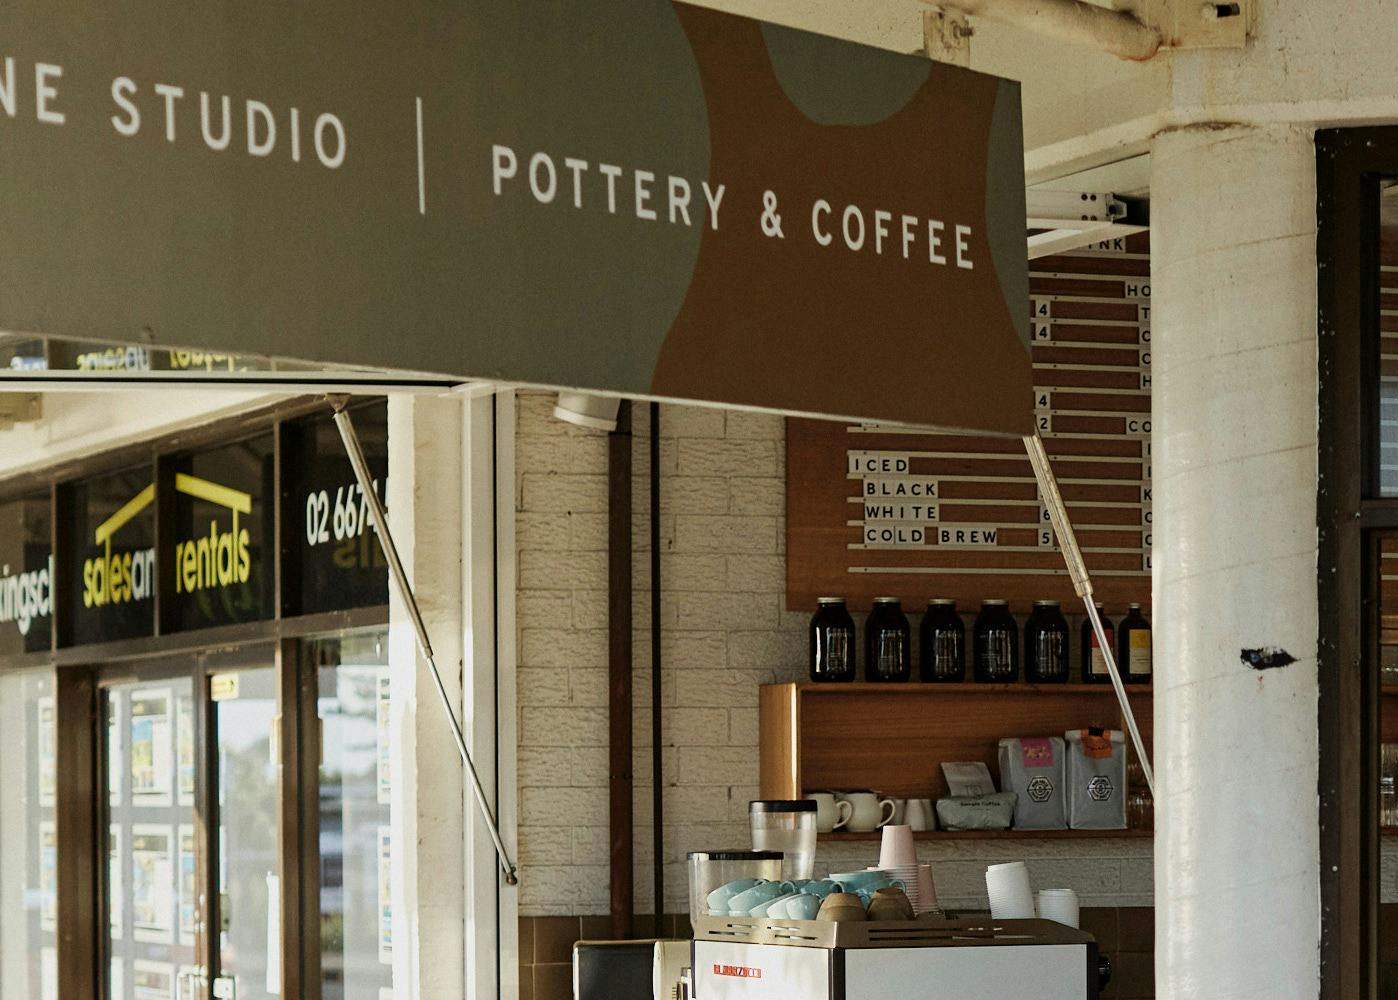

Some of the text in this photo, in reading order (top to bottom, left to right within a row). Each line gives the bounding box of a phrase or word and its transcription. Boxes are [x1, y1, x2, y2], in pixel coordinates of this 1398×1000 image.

[111, 76, 348, 169] STUDIO
[492, 144, 975, 269] POTTERY & COFFEE
[1038, 304, 1048, 316] 4
[1038, 326, 1048, 338] 4
[1038, 394, 1048, 407] 4
[1040, 417, 1048, 430] 2
[855, 458, 907, 472] ICED
[866, 482, 936, 496] BLACK
[306, 490, 330, 546] 02
[866, 506, 1051, 520] WHITE 6
[866, 529, 1050, 544] COLD BREW 5
[176, 504, 250, 594] rentals
